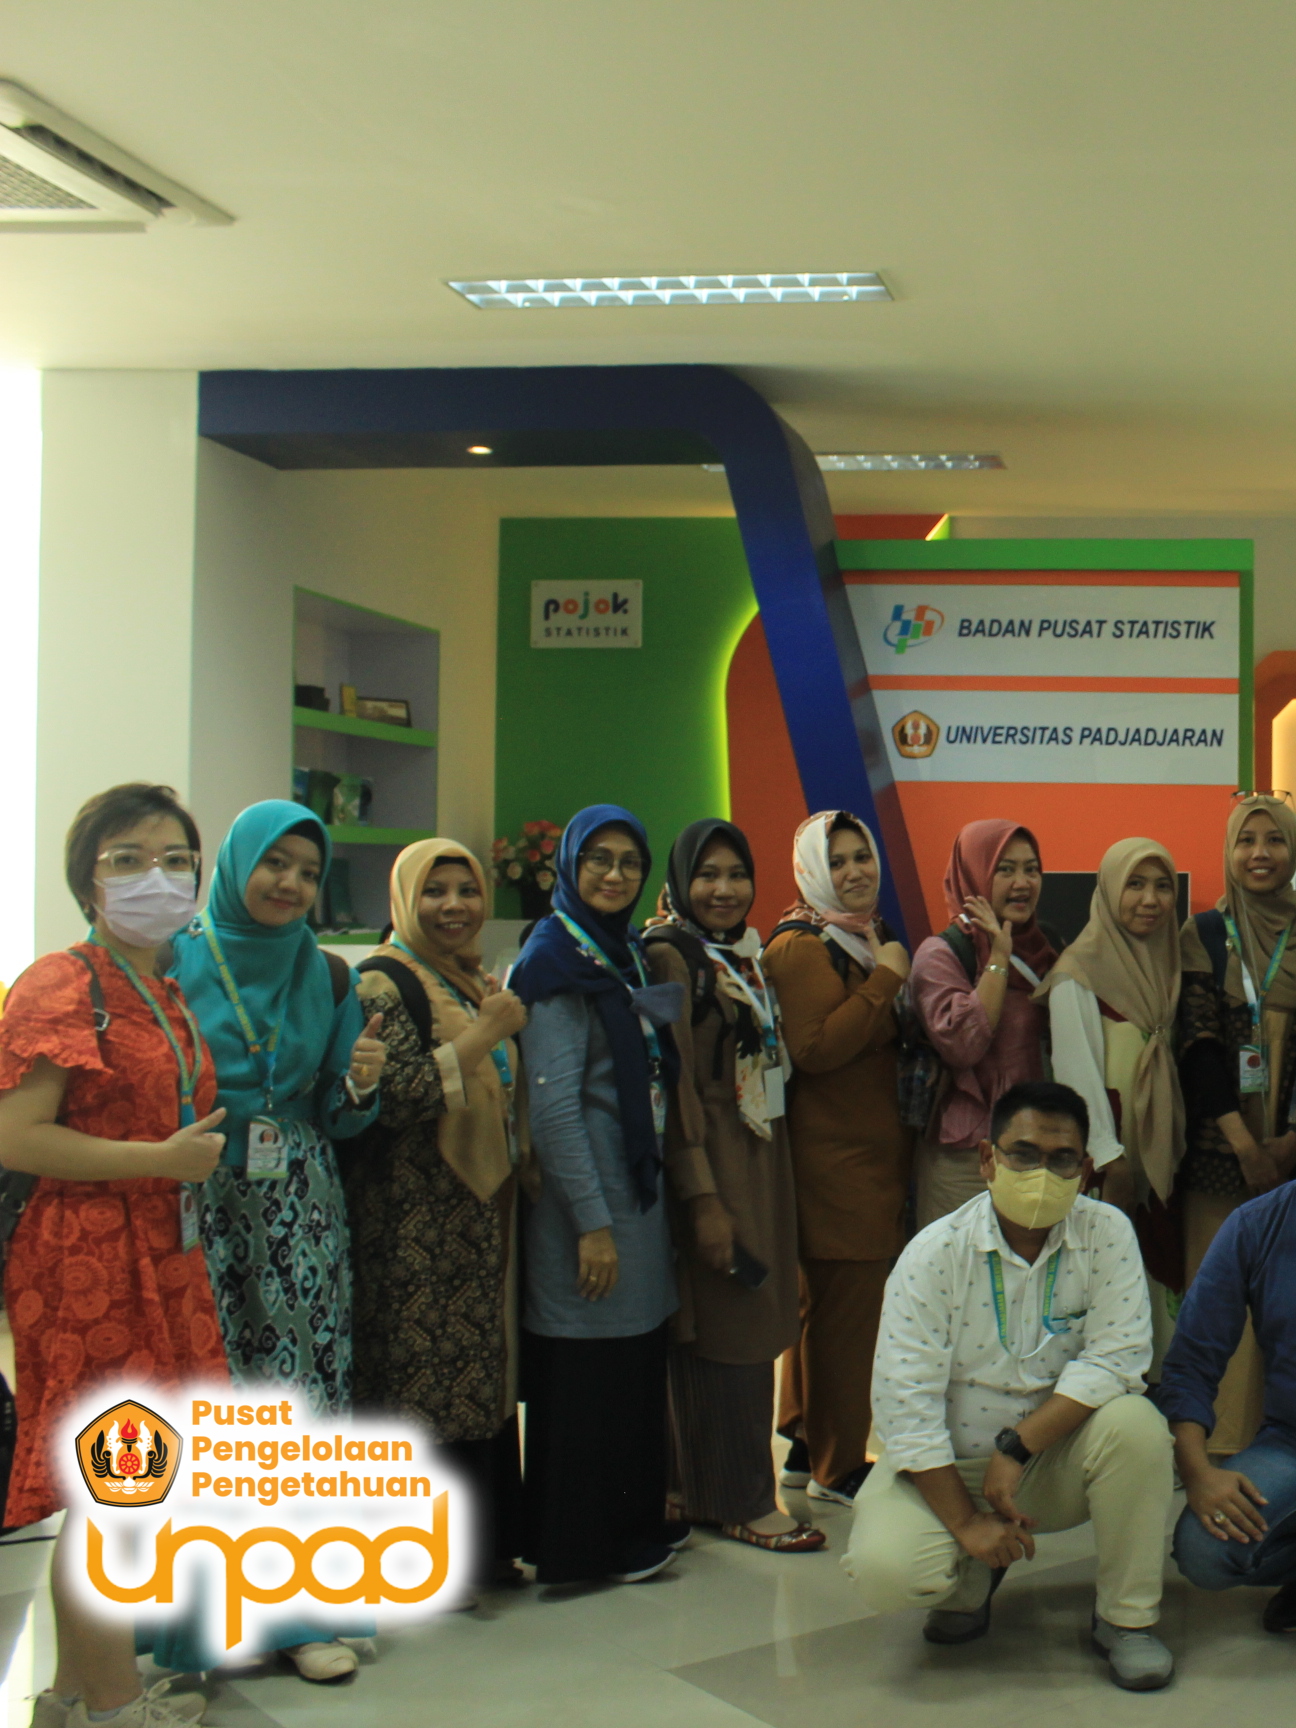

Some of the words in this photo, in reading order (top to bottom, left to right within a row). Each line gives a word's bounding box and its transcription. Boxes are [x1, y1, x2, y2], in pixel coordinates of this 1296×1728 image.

[543, 591, 629, 620] pojok
[544, 626, 629, 637] STATISTIK
[958, 619, 1033, 638] BADAN
[1037, 619, 1108, 639] PUSAT
[1112, 620, 1216, 640] STATISTIK
[946, 726, 1074, 746] UNIVERSITAS
[1079, 728, 1225, 748] PADJADJARAN
